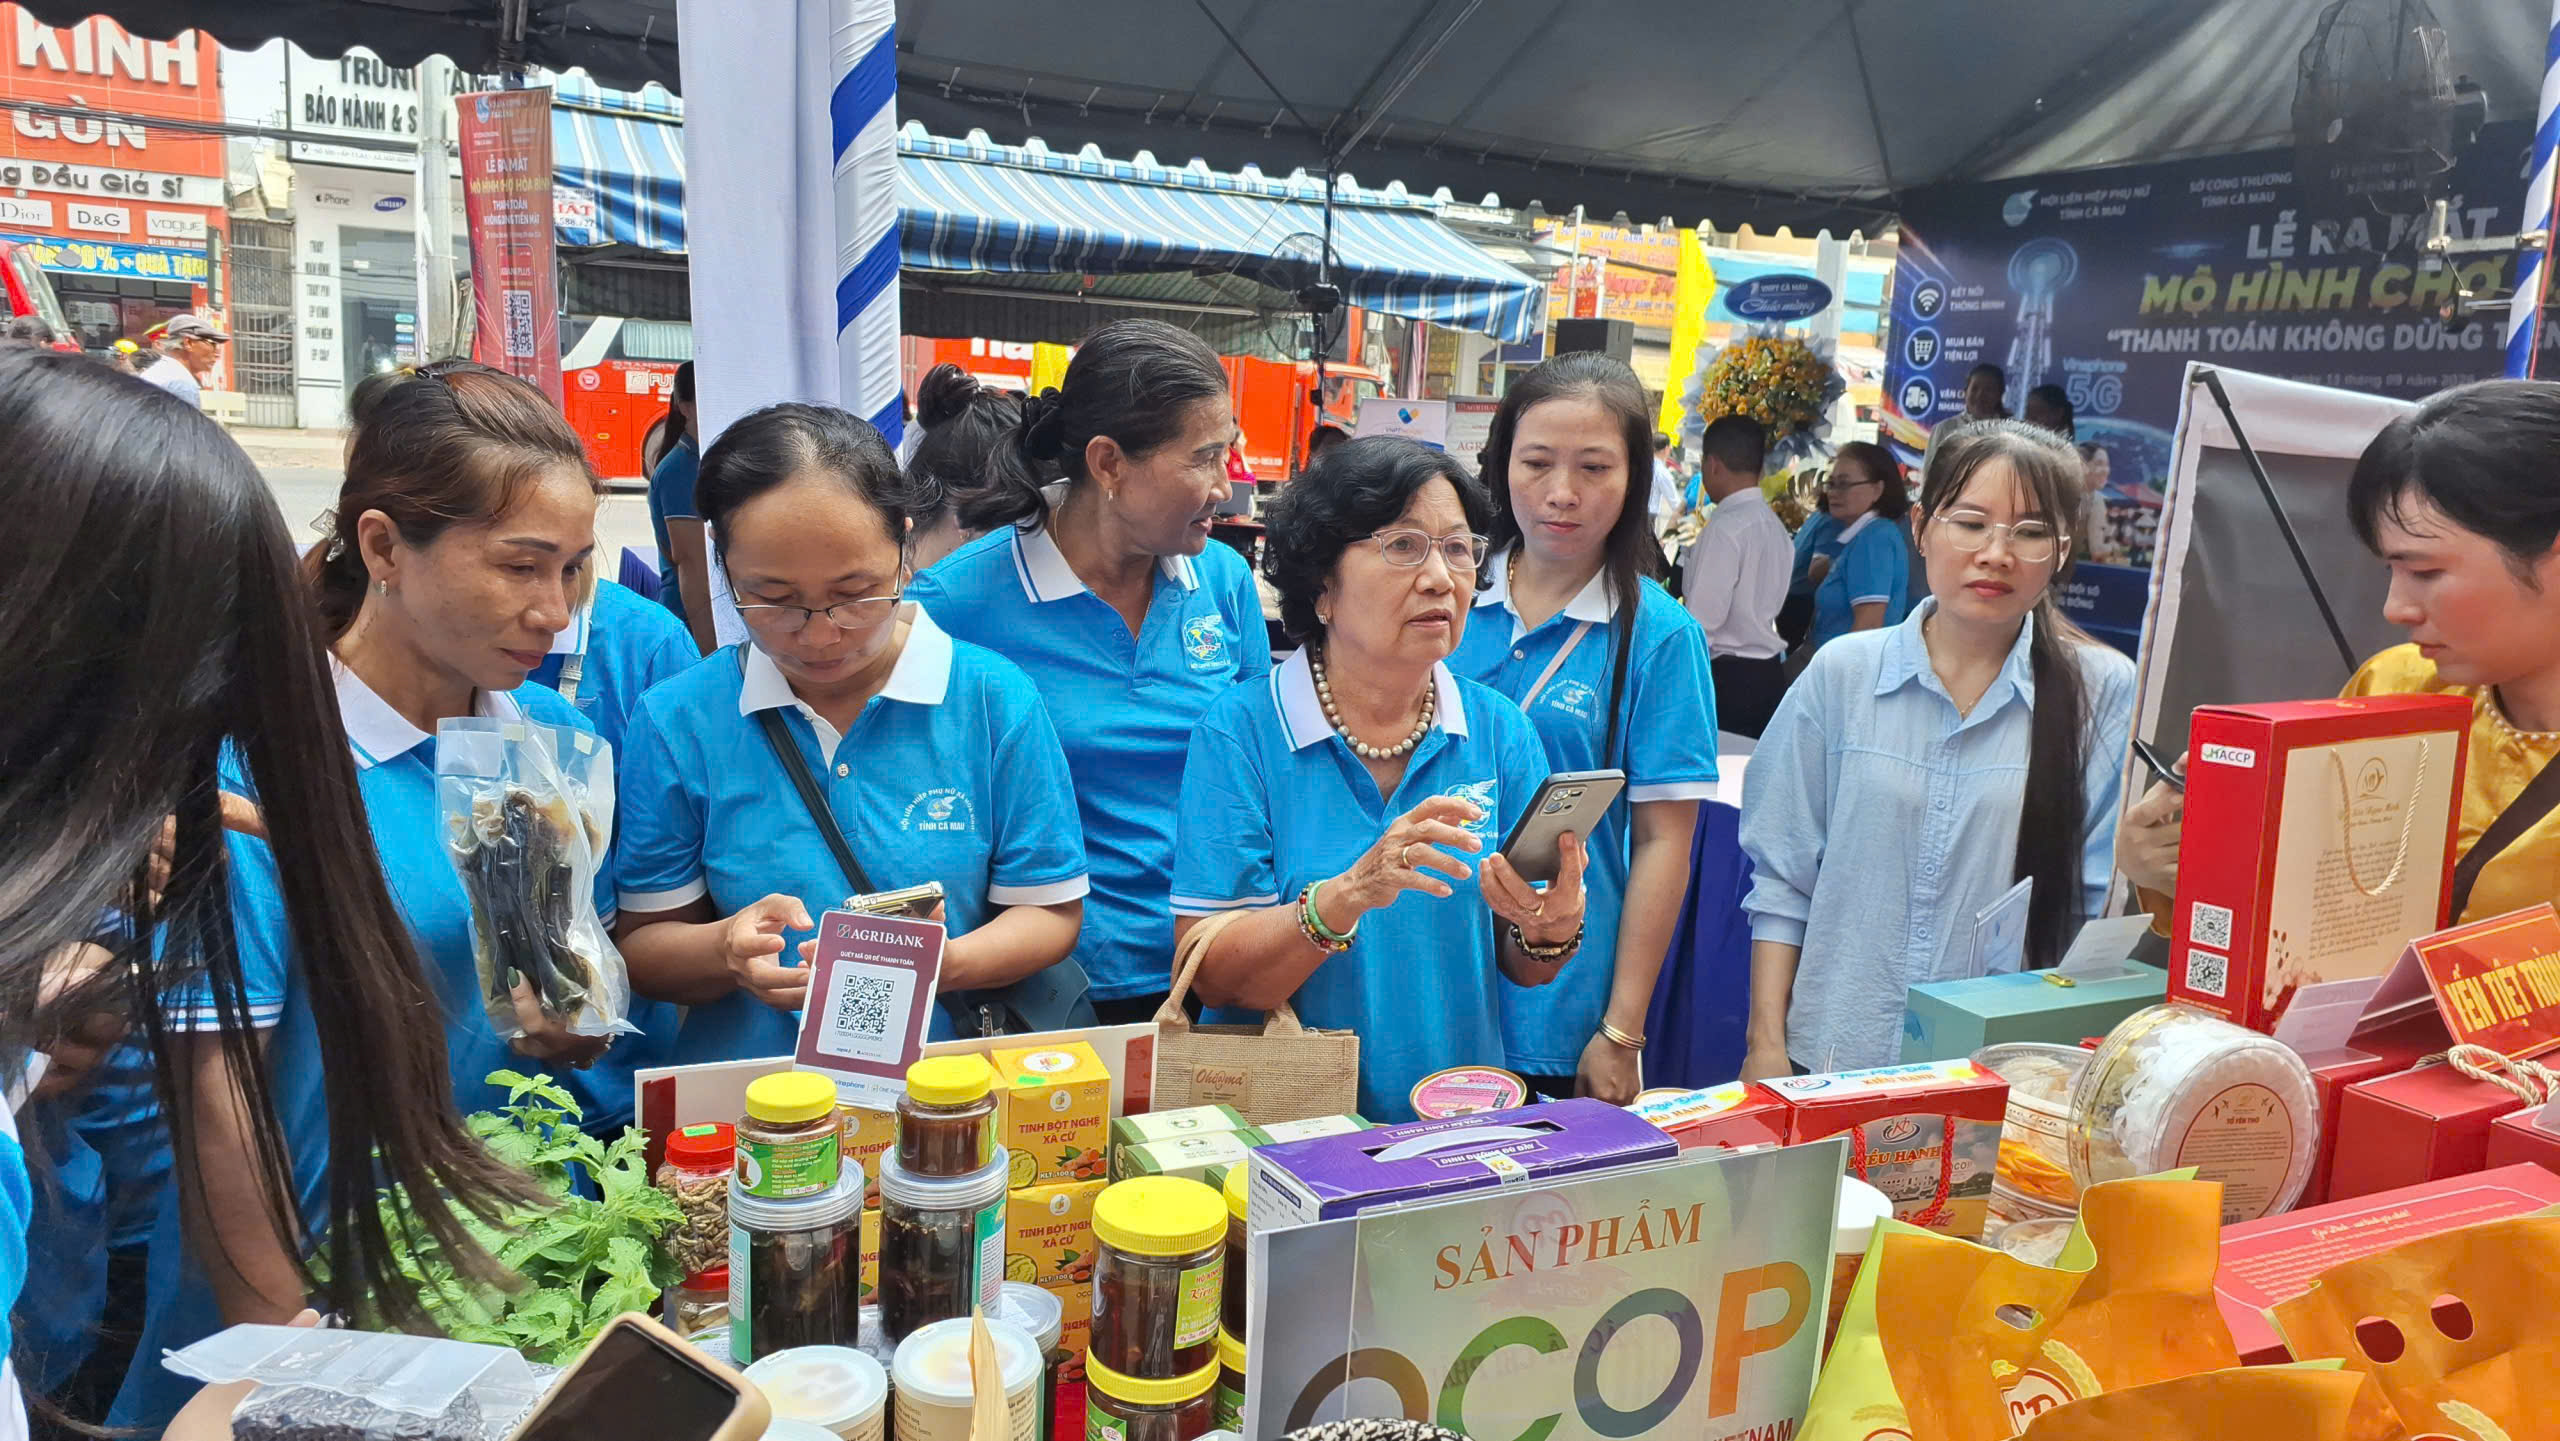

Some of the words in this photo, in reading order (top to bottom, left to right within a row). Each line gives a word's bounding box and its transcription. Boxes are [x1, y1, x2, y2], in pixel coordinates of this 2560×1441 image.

[305, 86, 337, 126] BẢO
[343, 94, 386, 131] HÀNH
[392, 104, 403, 132] &
[100, 173, 149, 195] Giá
[77, 210, 121, 227] D&G
[2225, 261, 2361, 313] HÌNH
[2207, 320, 2277, 353] TOÁN
[2283, 318, 2385, 353] KHÔNG
[2066, 374, 2123, 414] 5G
[2204, 746, 2251, 764] HACCP
[850, 926, 925, 949] AGRIBANK
[2444, 962, 2498, 1033] YẾN
[1018, 1122, 1045, 1134] TINH
[1047, 1119, 1069, 1133] BỘT
[1070, 1115, 1101, 1129] NGHỆ
[1018, 1227, 1045, 1239] TINH
[1046, 1223, 1069, 1237] BỘT
[1069, 1220, 1092, 1232] NGH
[1432, 1225, 1540, 1292] SẢN
[1551, 1198, 1706, 1268] PHẨM
[1283, 1260, 1813, 1441] OCOP
